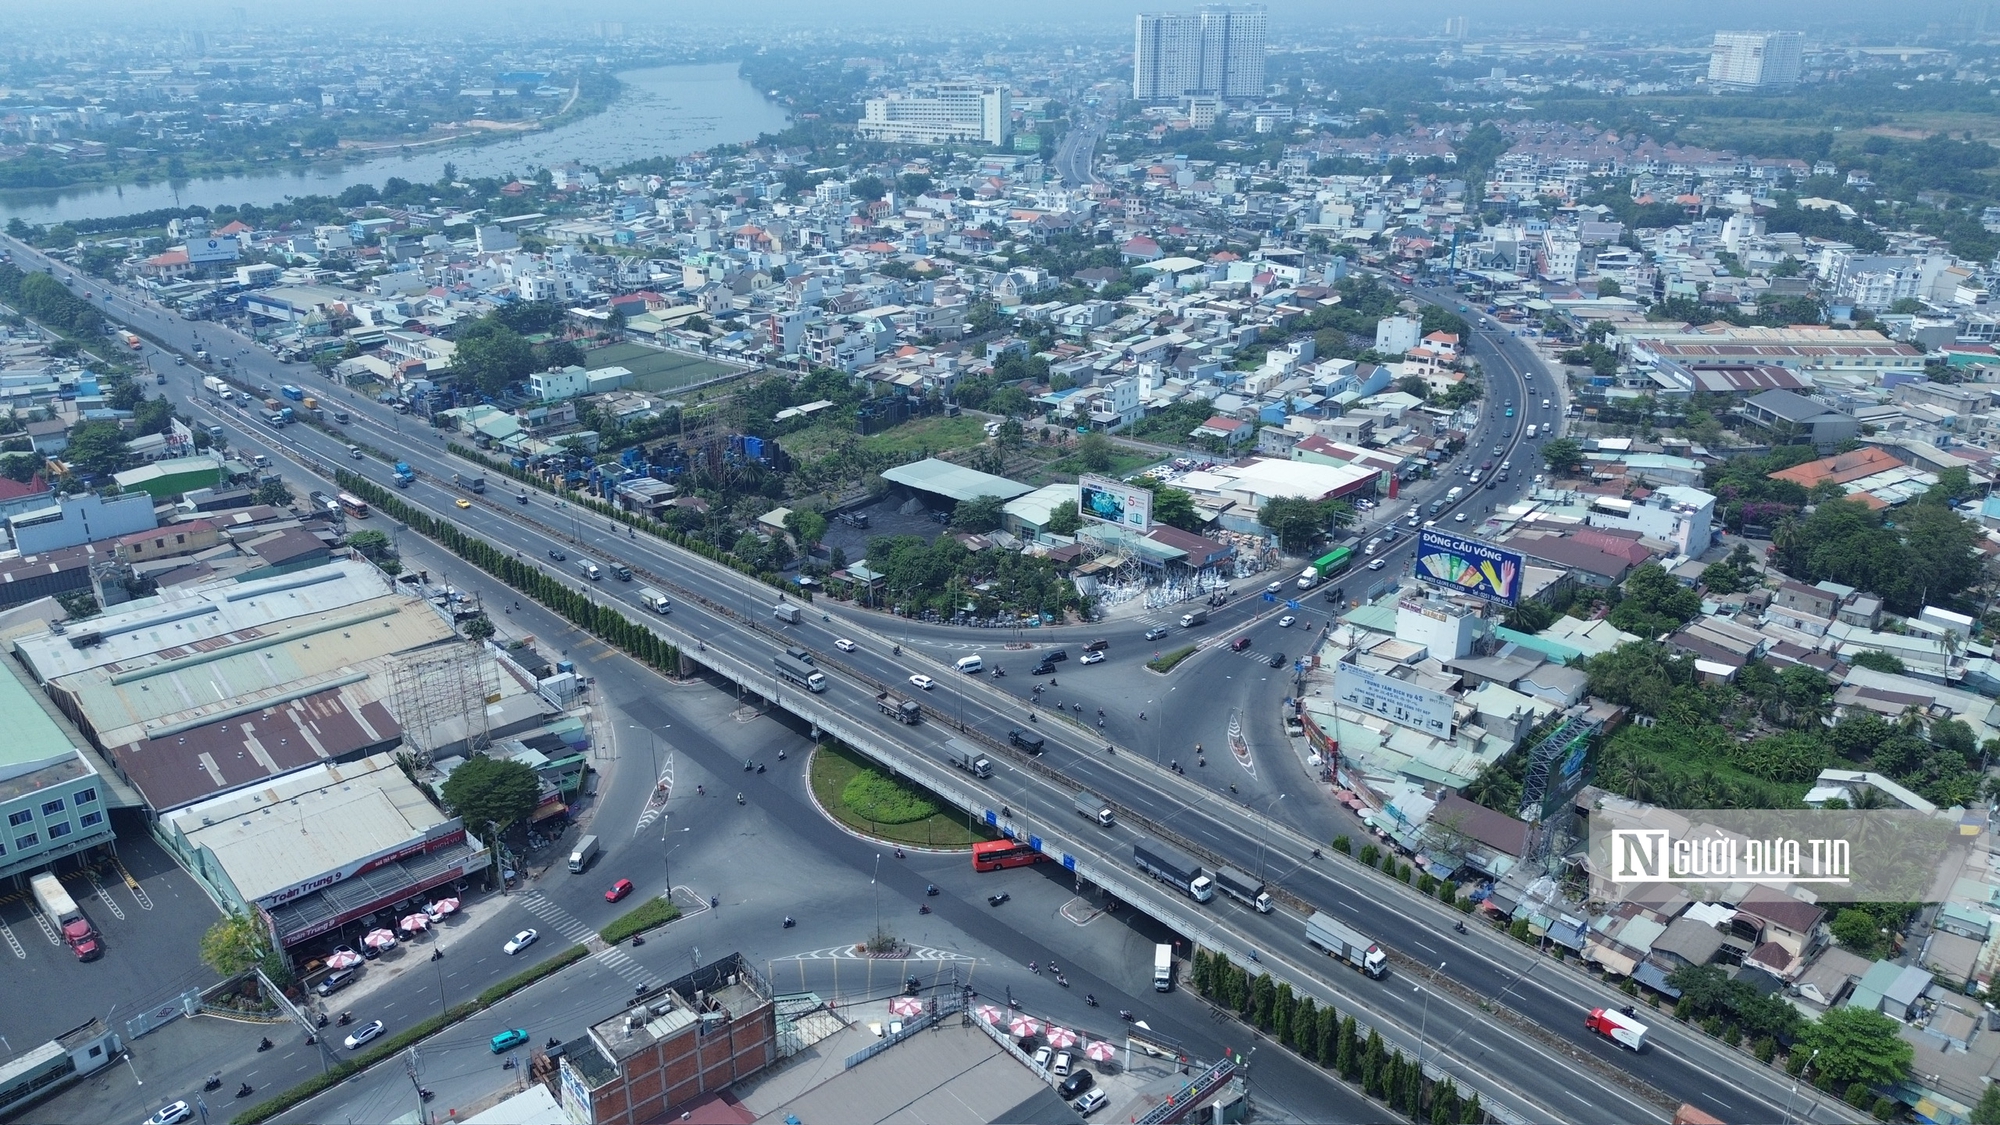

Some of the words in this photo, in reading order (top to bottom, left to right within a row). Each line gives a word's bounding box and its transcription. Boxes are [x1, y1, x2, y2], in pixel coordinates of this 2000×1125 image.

[1128, 495, 1135, 506] 5
[1423, 533, 1451, 548] ĐÔNG
[1364, 679, 1380, 688] TRUNG
[271, 887, 300, 904] Toàn
[300, 875, 333, 892] Trung
[335, 871, 342, 880] 9
[306, 923, 328, 936] Trung
